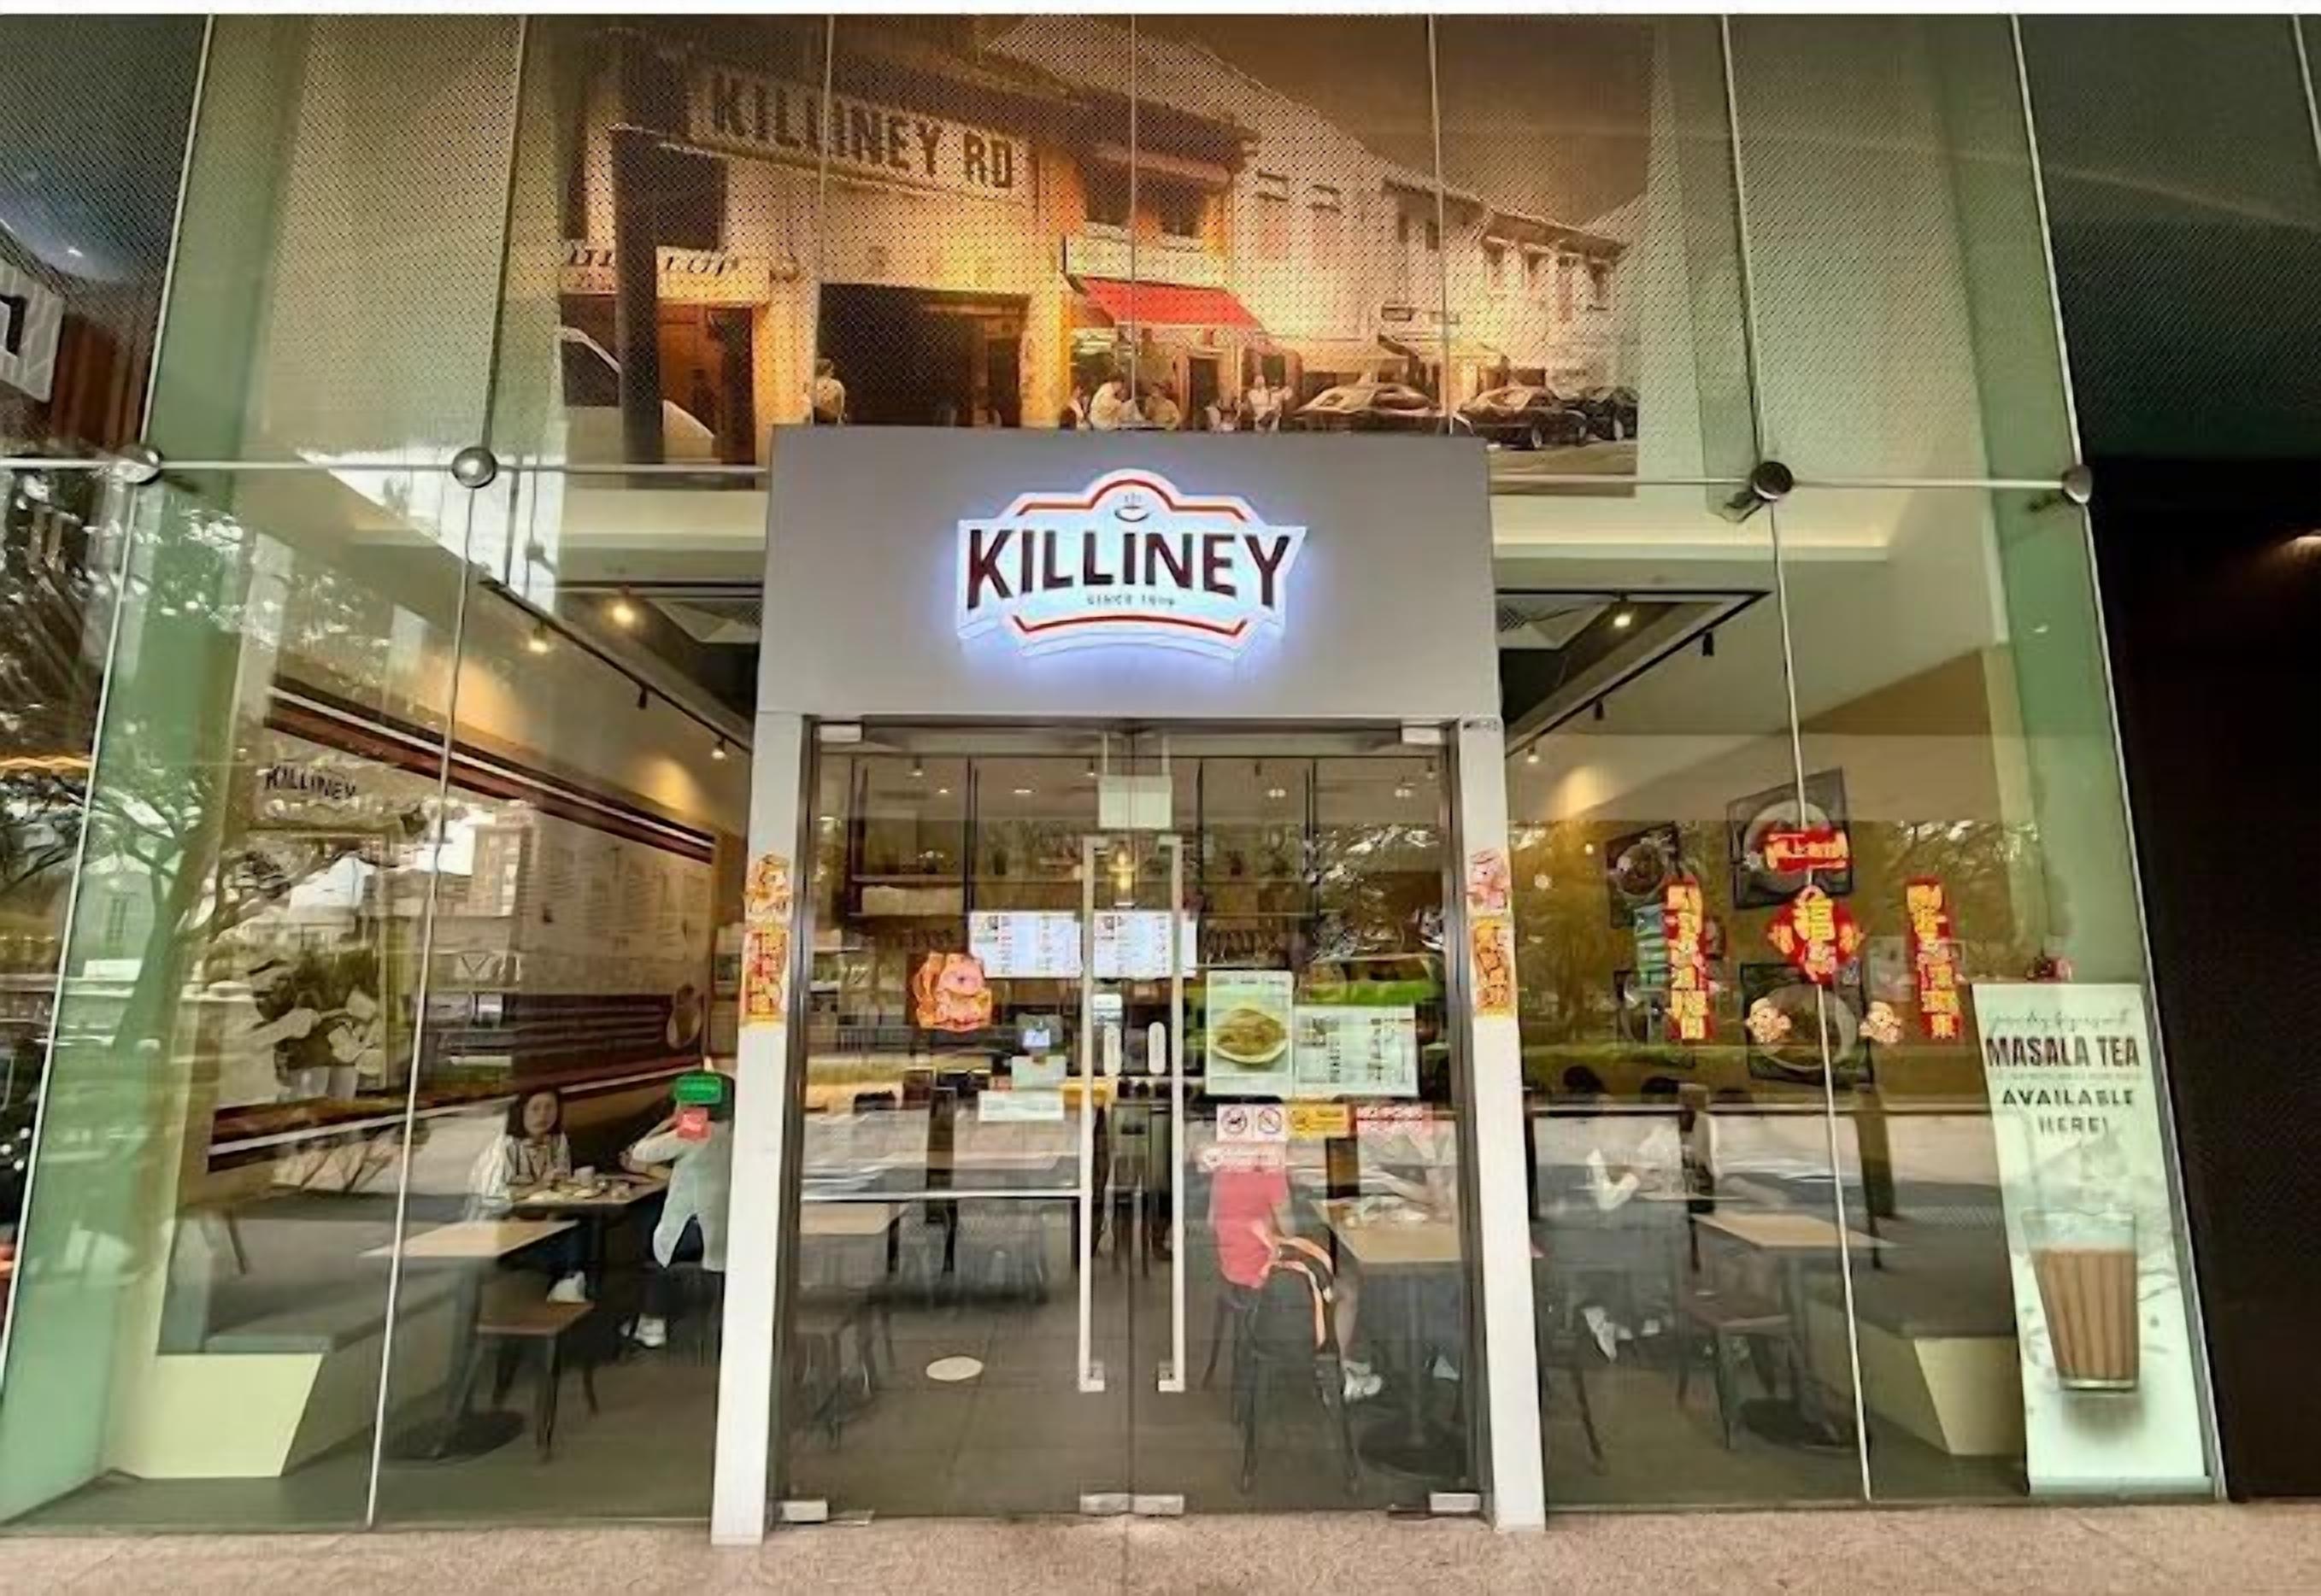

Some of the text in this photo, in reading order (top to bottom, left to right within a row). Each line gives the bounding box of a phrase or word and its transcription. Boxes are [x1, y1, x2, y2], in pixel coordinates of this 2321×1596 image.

[711, 71, 1014, 189] KILLINEY RD
[967, 528, 1290, 611] KILLINEY
[1985, 1036, 2140, 1067] MASALA TEA
[2001, 1088, 2134, 1106] AVAILABLE
